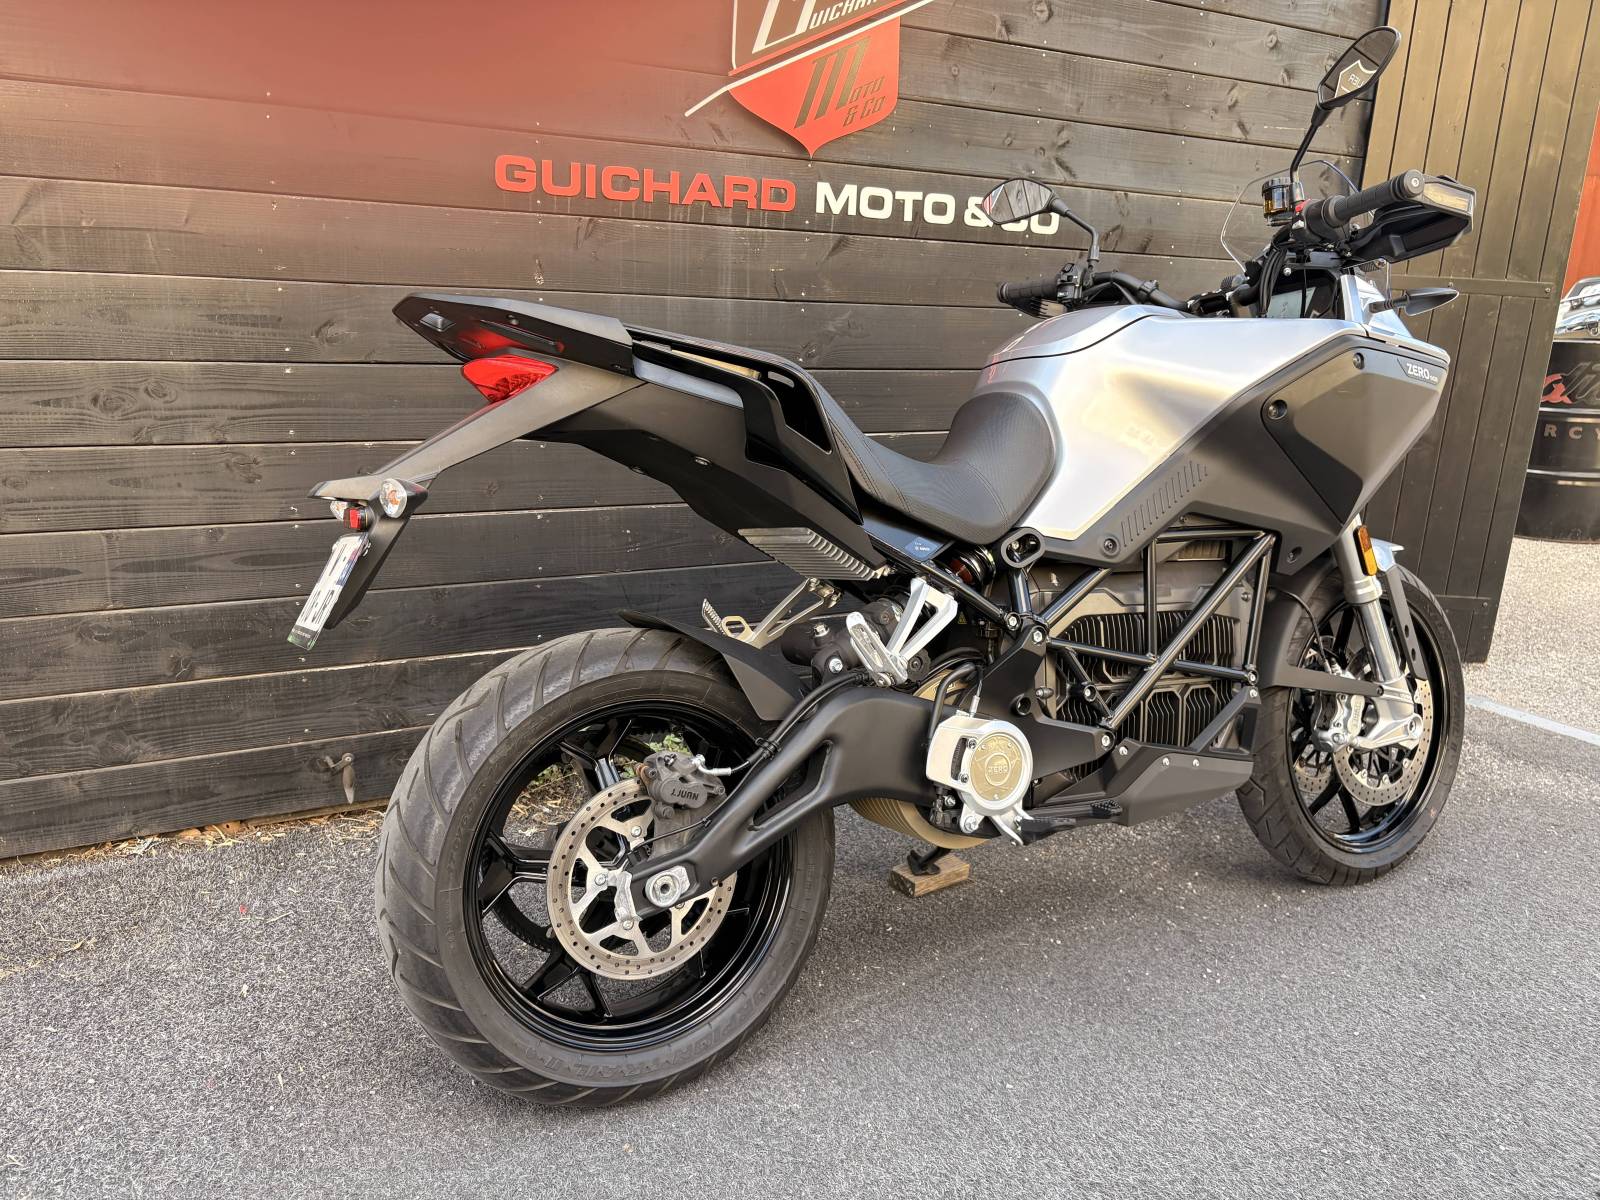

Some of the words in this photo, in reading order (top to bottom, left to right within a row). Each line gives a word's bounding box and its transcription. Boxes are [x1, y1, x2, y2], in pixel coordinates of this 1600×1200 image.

[495, 154, 796, 212] GUICHARD
[815, 181, 955, 225] MOTO
[964, 196, 993, 227] &
[1406, 362, 1430, 380] ZERO
